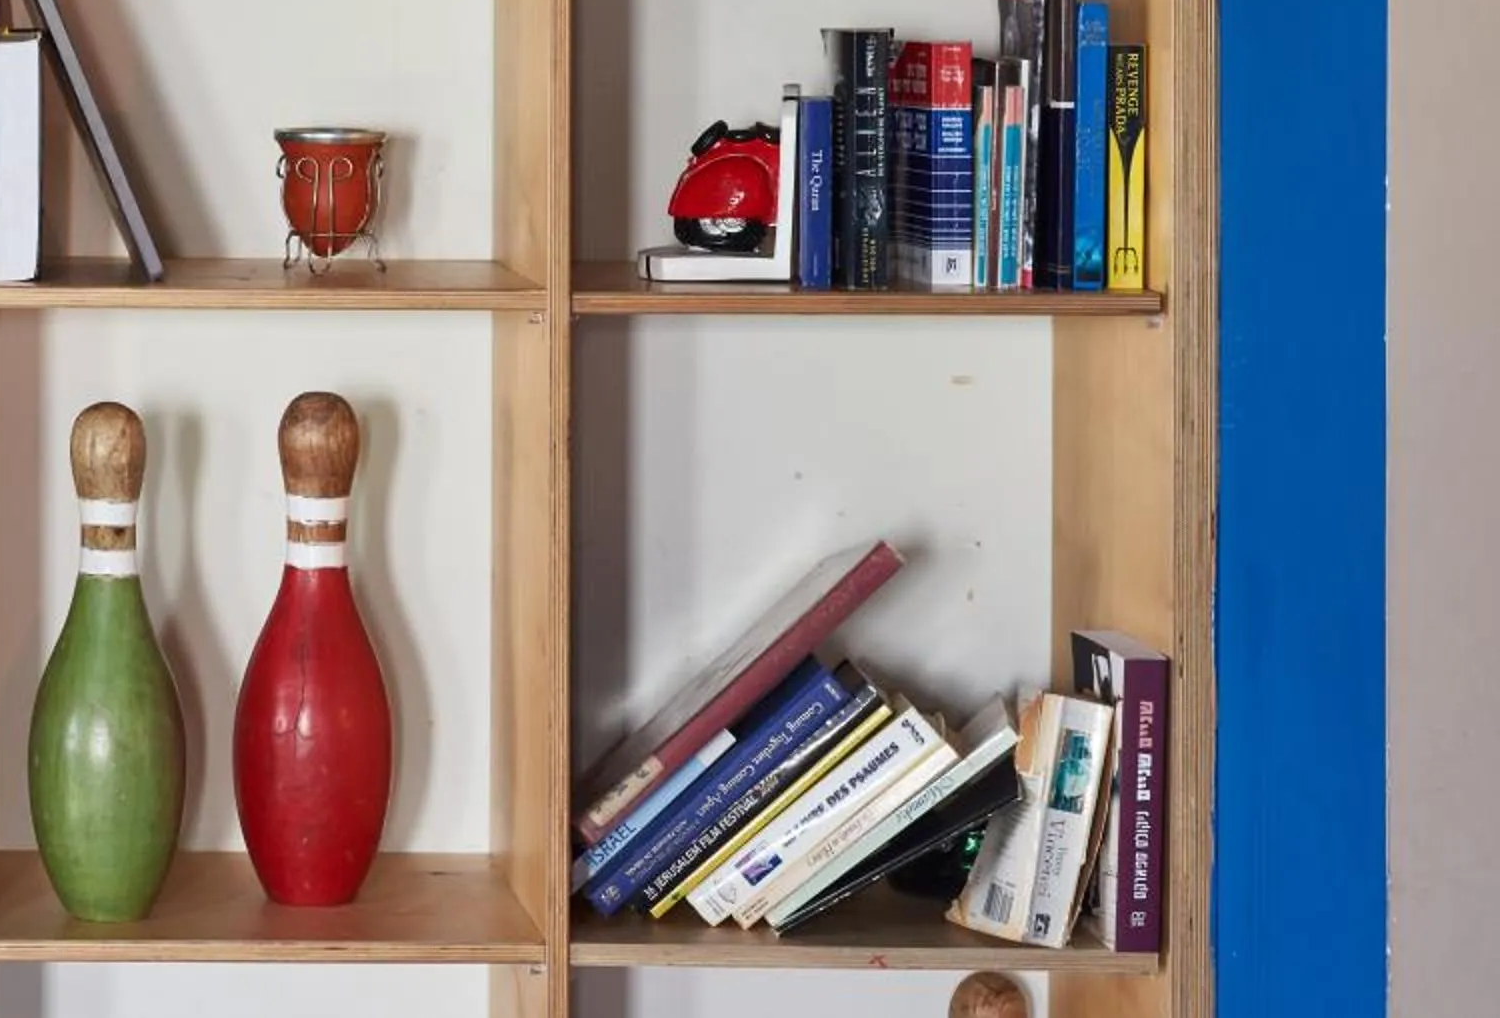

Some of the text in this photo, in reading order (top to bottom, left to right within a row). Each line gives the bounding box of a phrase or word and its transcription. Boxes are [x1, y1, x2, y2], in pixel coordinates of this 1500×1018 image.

[1115, 87, 1128, 135] PRADA
[1127, 52, 1139, 117] REVENGE
[854, 85, 877, 178] ALIEN
[809, 149, 824, 211] The Quran
[825, 785, 849, 805] DES
[846, 741, 901, 787] PSAUMES
[1136, 752, 1152, 802] שניים
[586, 820, 638, 868] ISRAEL
[653, 843, 702, 889] JERUSALEM
[698, 826, 721, 847] FILM
[717, 792, 757, 830] FESTIVAL
